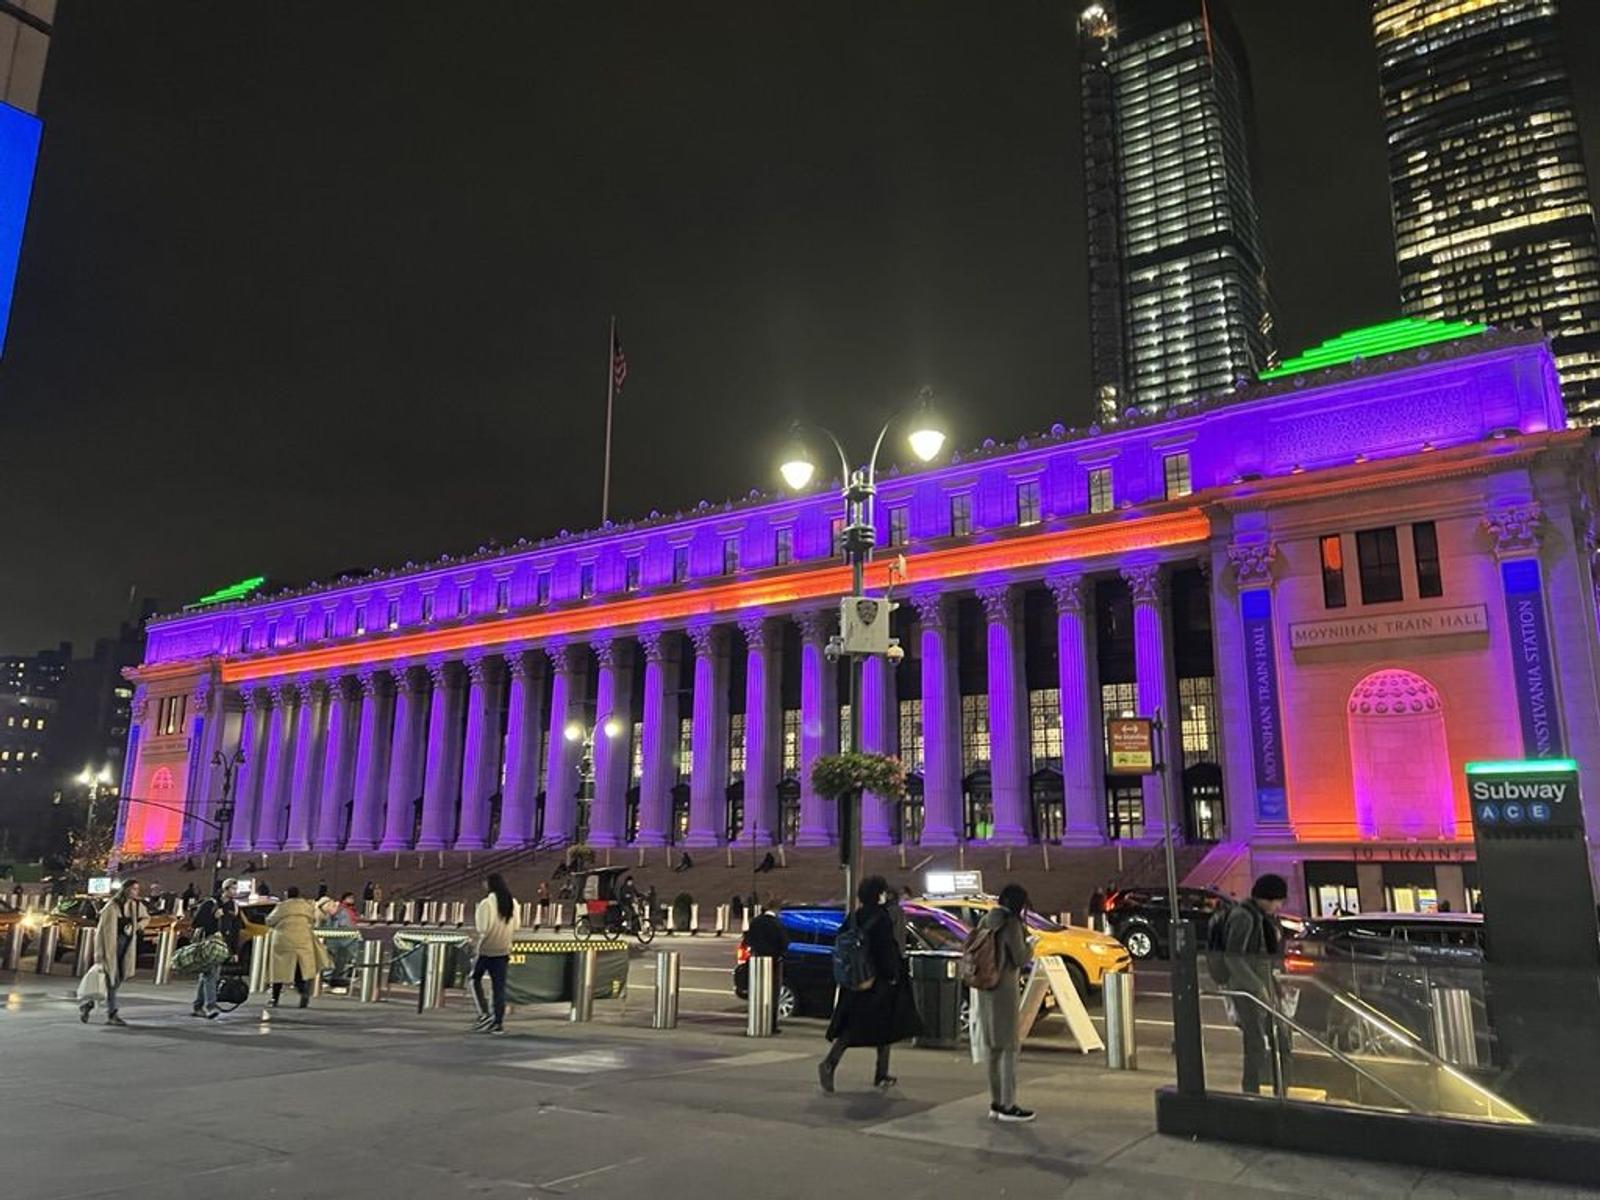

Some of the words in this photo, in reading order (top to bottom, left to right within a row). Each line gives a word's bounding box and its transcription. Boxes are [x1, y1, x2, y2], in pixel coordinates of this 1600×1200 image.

[1253, 625, 1267, 658] HALL
[1294, 623, 1377, 642] MOYNIHAN
[1386, 616, 1432, 633] TRAIN
[1440, 612, 1481, 628] HALL
[1519, 600, 1540, 662] STATION
[1255, 661, 1271, 701] TRAIN
[1528, 665, 1552, 759] NNSYLVANIA
[1260, 705, 1277, 783] MOYNIHAN
[1473, 781, 1567, 803] Subway
[1482, 805, 1495, 819] A
[1506, 805, 1519, 819] C
[1532, 804, 1545, 818] E
[1352, 847, 1374, 860] TO
[1387, 847, 1466, 860] TRAINS
